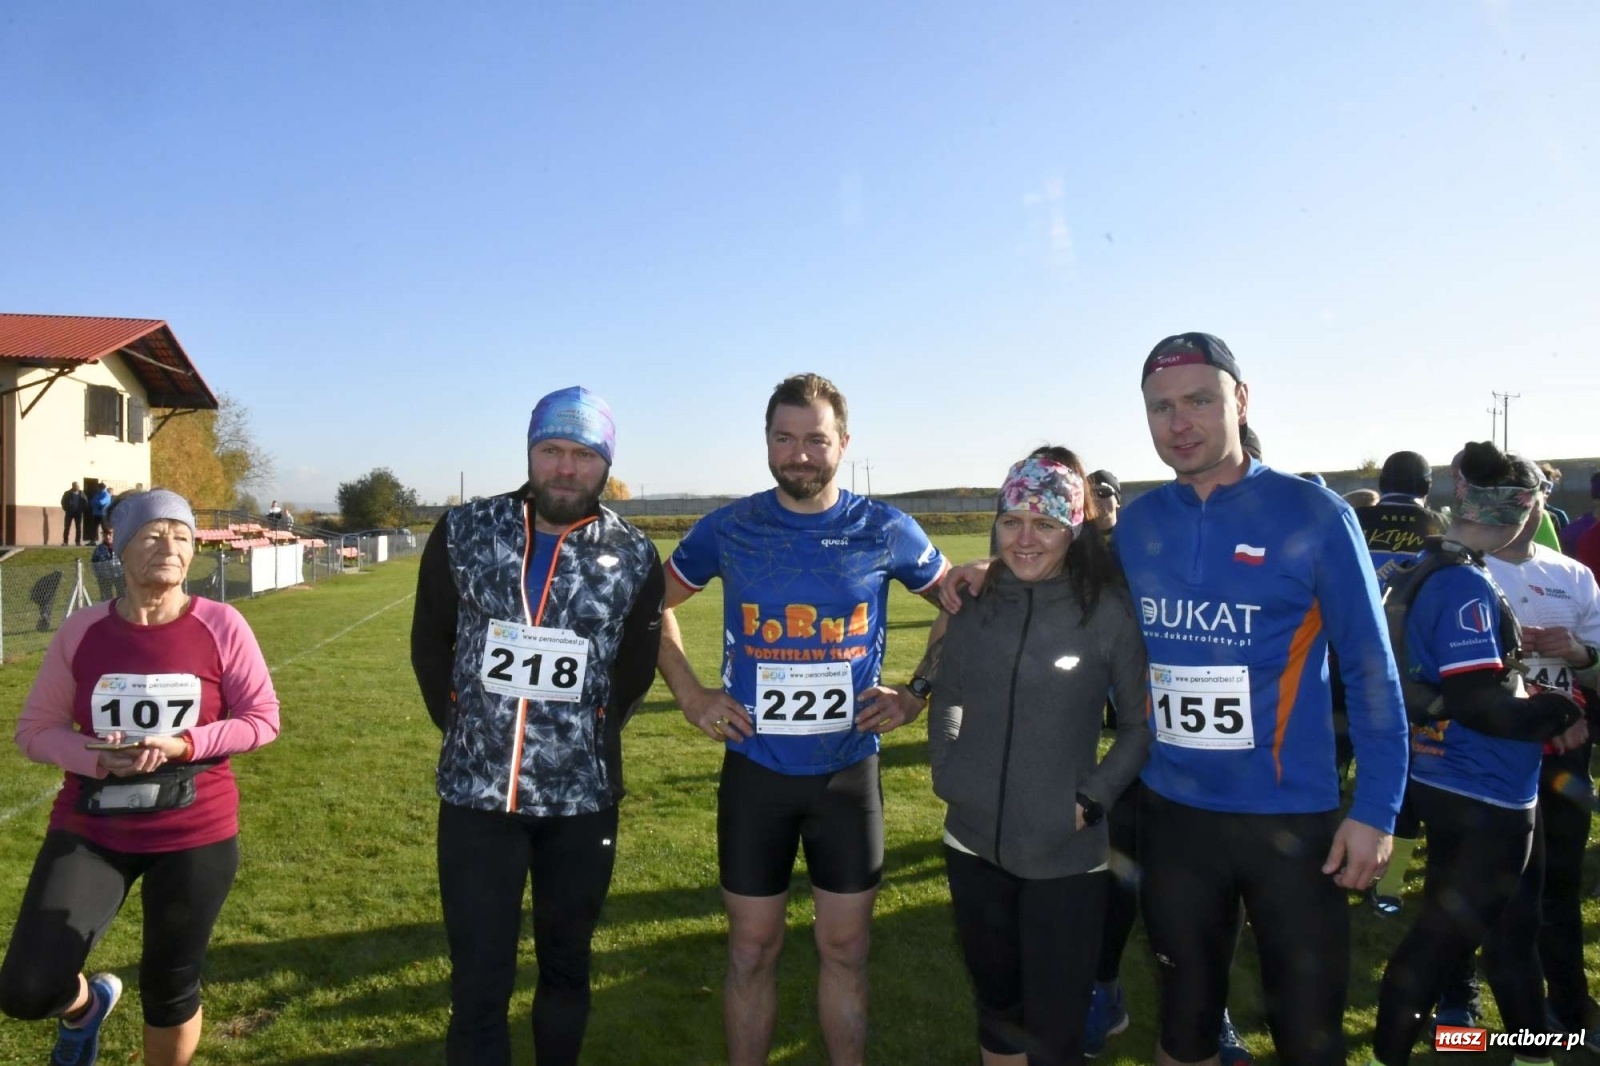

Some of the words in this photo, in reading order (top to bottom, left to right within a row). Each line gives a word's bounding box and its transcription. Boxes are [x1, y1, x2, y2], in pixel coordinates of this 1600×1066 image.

[821, 537, 849, 548] quest
[1141, 597, 1262, 634] DUKAT
[1142, 630, 1252, 648] www.dukatrolety.pl
[487, 647, 579, 690] 218
[101, 699, 195, 730] 107
[762, 688, 847, 722] 222
[1158, 694, 1245, 734] 155
